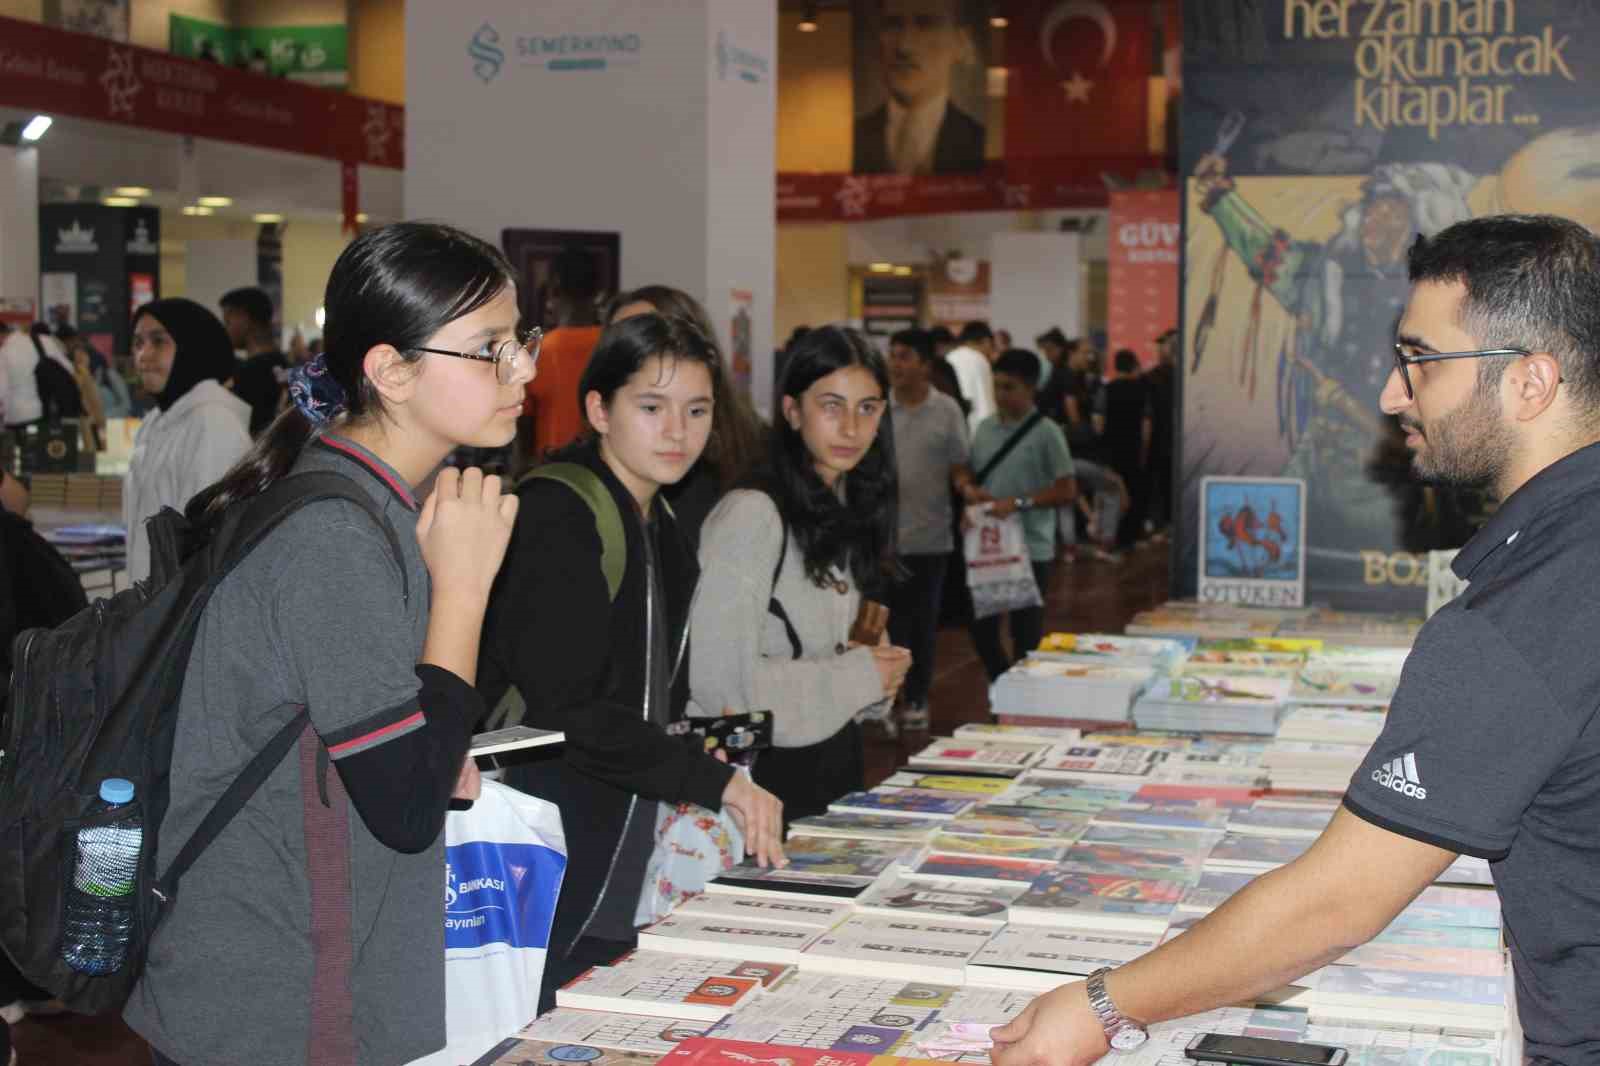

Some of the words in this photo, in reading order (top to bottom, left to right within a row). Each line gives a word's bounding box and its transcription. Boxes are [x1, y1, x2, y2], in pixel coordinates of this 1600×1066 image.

[1283, 0, 1349, 39] her
[1359, 0, 1516, 37] zaman
[1354, 25, 1575, 82] okunacak
[1371, 769, 1427, 800] adidas
